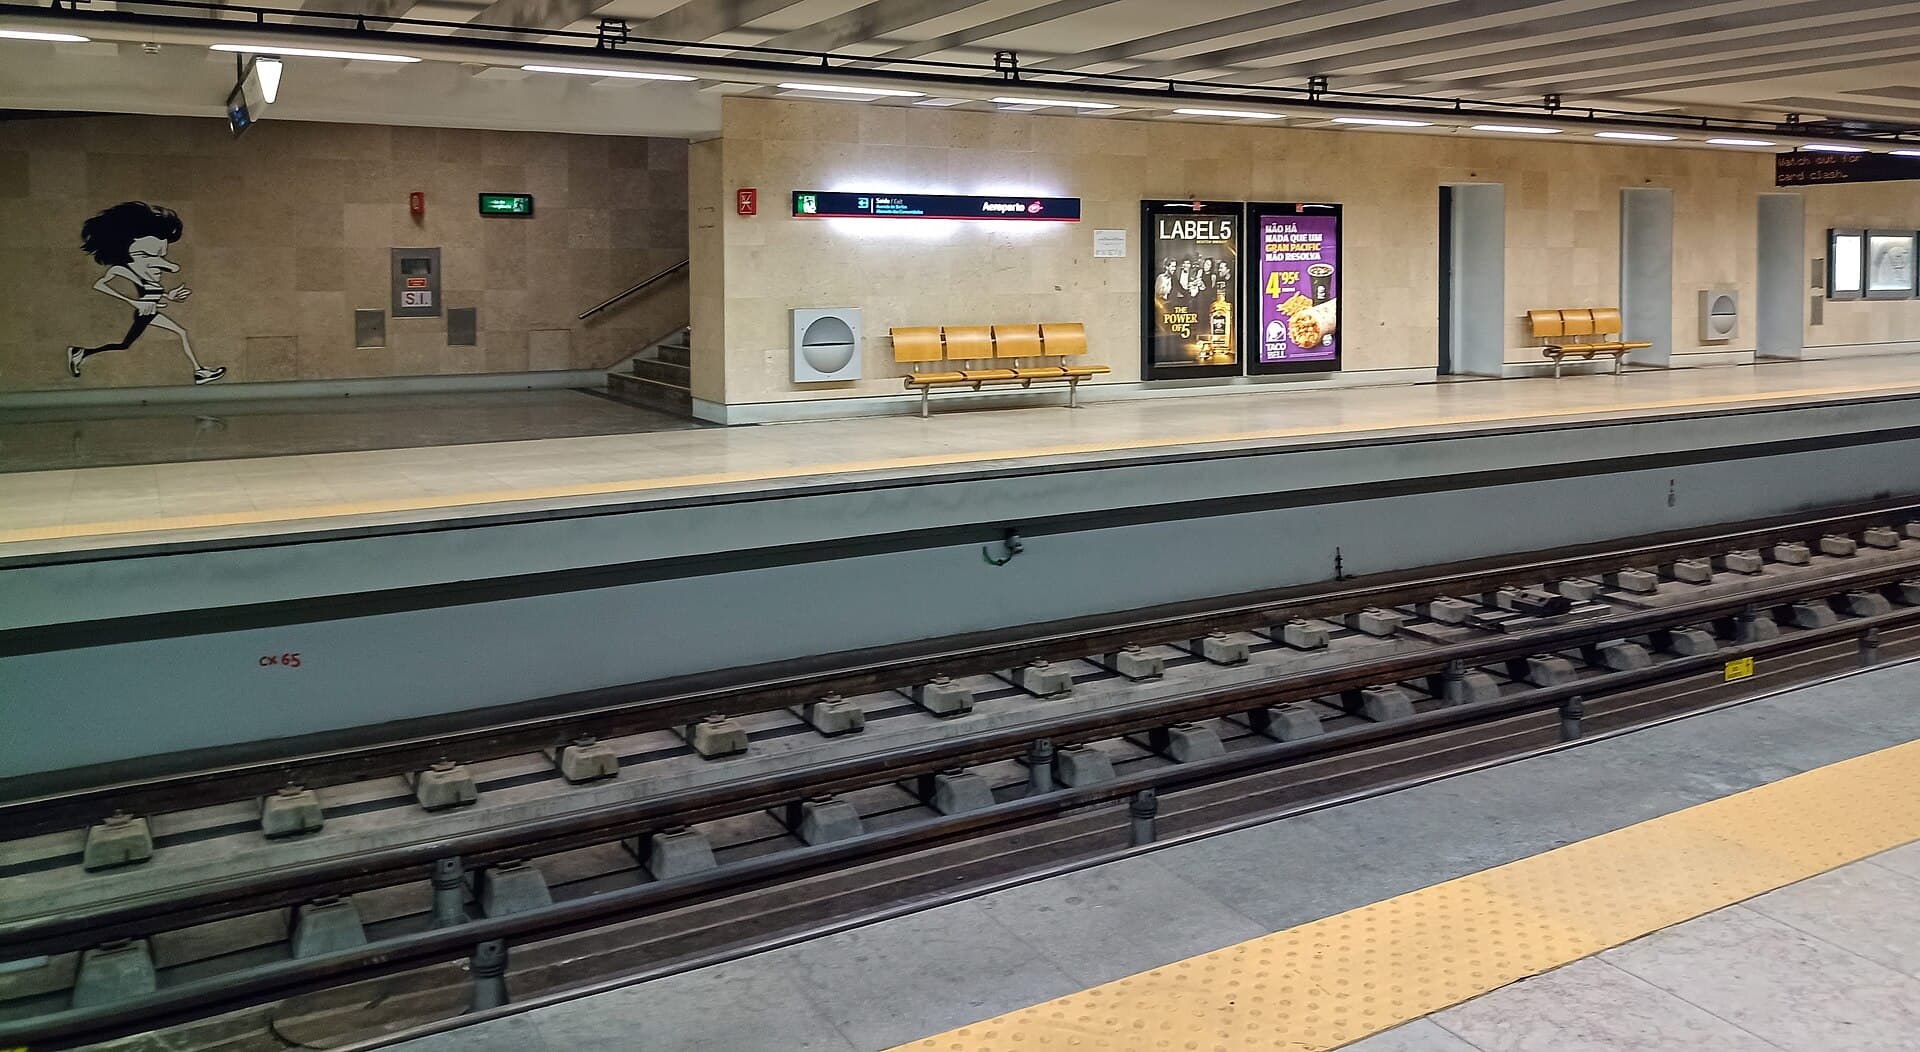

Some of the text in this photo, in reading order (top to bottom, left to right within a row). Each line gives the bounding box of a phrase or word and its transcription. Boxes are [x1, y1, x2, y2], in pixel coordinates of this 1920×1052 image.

[1778, 172, 1805, 181] card
[982, 201, 1026, 214] Aeroporto
[1265, 222, 1298, 233] NÃO HÁ
[1265, 233, 1323, 243] NADA QUE UM
[1265, 243, 1322, 252] GRAN PACIFIC
[1265, 251, 1322, 262] NÃO RESOLVA
[1174, 306, 1189, 314] THE
[1163, 313, 1198, 324] POWER
[1171, 323, 1191, 339] OF 5
[1265, 342, 1287, 351] TACO
[1267, 351, 1287, 359] BELL
[281, 653, 301, 668] 65
